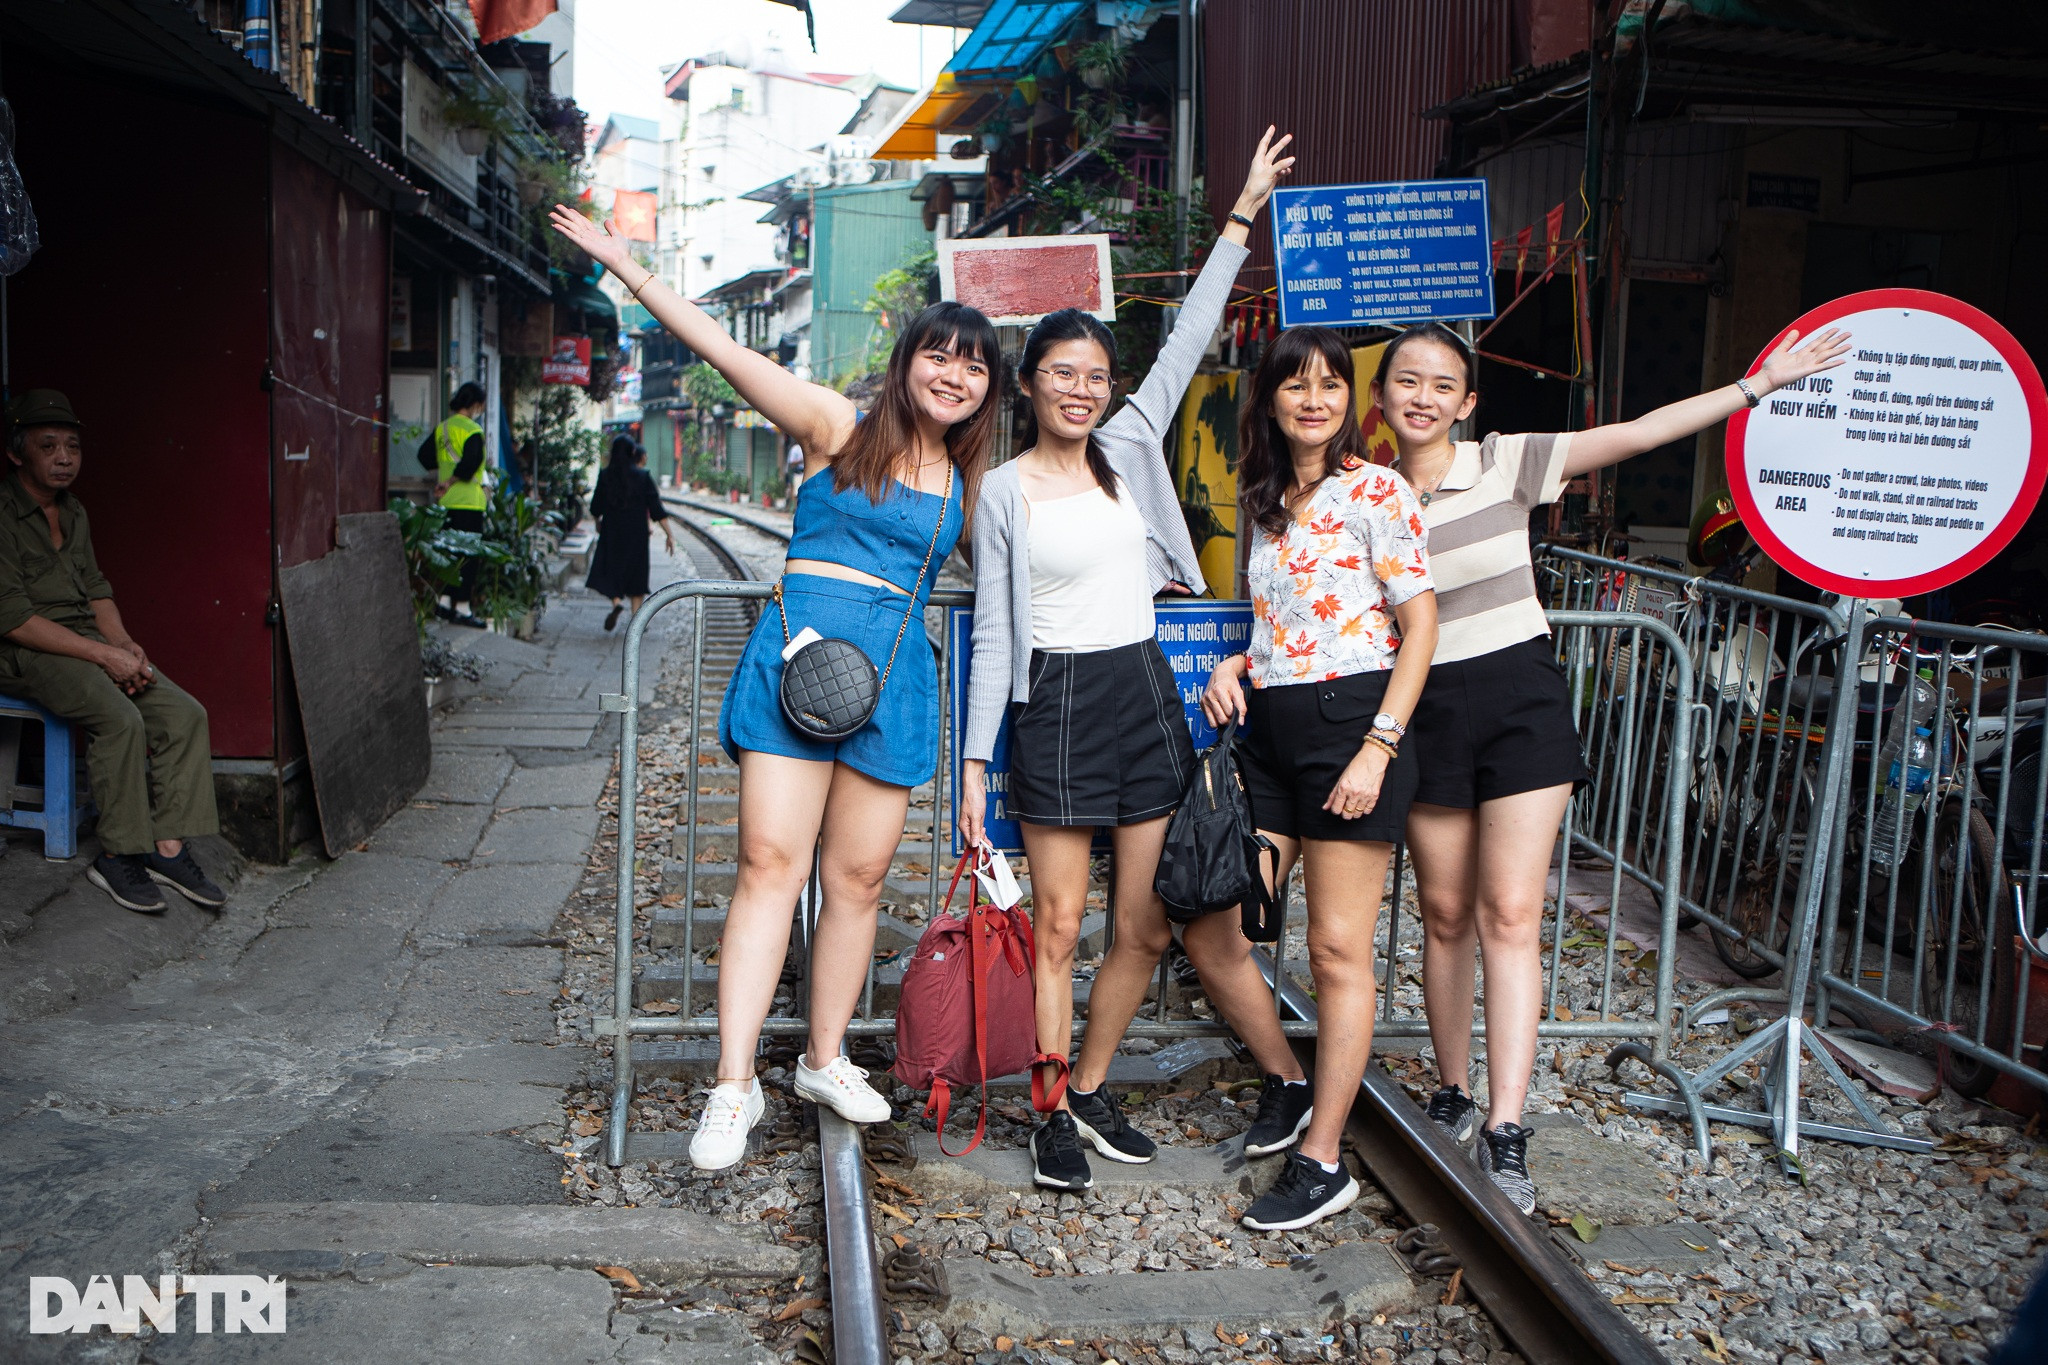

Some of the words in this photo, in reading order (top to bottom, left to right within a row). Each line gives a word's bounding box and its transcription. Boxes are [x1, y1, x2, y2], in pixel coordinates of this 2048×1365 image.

[1422, 191, 1436, 204] QUAY
[1286, 206, 1308, 222] KHU
[1311, 204, 1333, 225] VỰC
[1283, 233, 1312, 249] NGUY
[1315, 225, 1343, 247] HIỂM
[1444, 226, 1462, 237] TRONG
[1357, 251, 1368, 262] HAI
[1352, 268, 1360, 276] DO
[1361, 267, 1372, 276] NOT
[1373, 266, 1394, 275] GATHER
[1395, 265, 1399, 274] A
[1460, 262, 1479, 271] VIDEOS
[1287, 278, 1342, 292] DANGEROUS
[1353, 282, 1362, 290] DO
[1363, 281, 1374, 290] NOT
[1413, 278, 1421, 286] SIT
[1423, 277, 1431, 286] ON
[1432, 276, 1457, 285] RAILROAD
[1458, 275, 1479, 284] TRACKS
[1303, 297, 1327, 311] AREA
[1363, 294, 1375, 303] NOT
[1375, 293, 1398, 302] DISPLAY
[1421, 291, 1441, 300] TABLES
[1442, 290, 1453, 299] AND
[1475, 289, 1483, 297] ON
[1352, 309, 1364, 318] AND
[1365, 308, 1382, 317] ALONG
[1384, 306, 1410, 316] RAILROAD
[1411, 305, 1431, 314] TRACKS
[1858, 350, 1883, 364] Không
[1885, 352, 1893, 366] tụ
[1895, 353, 1908, 367] tập
[1910, 354, 1930, 368] đông
[1932, 356, 1957, 370] người,
[1959, 359, 1979, 372] quay
[1981, 361, 2004, 374] phim,
[1810, 377, 1833, 396] VỰC
[1854, 371, 1874, 384] chụp
[1876, 370, 1891, 383] ảnh
[1770, 400, 1803, 417] NGUY
[1806, 398, 1837, 420] HIỂM
[1852, 389, 1877, 403] Không
[1880, 391, 1889, 404] đi,
[1935, 395, 1951, 407] trên
[1954, 397, 1979, 411] đường
[1981, 397, 1994, 411] sắt
[1849, 408, 1875, 422] Không
[1876, 411, 1886, 422] kê
[1888, 411, 1904, 424] bàn
[1905, 412, 1922, 426] ghế,
[1958, 417, 1979, 431] hàng
[1846, 427, 1867, 441] trong
[1868, 429, 1886, 443] lòng
[1888, 431, 1898, 443] và
[1899, 432, 1912, 444] hai
[1914, 433, 1929, 446] bên
[1931, 435, 1957, 449] đường
[1958, 435, 1971, 449] sắt
[1759, 469, 1831, 489] DANGEROUS
[1842, 468, 1851, 480] Do
[1852, 470, 1864, 481] not
[1865, 472, 1888, 483] gather
[1889, 474, 1894, 483] a
[1895, 474, 1919, 487] crowd,
[1921, 476, 1936, 487] take
[1937, 477, 1962, 491] photos,
[1965, 480, 1988, 492] videos
[1775, 496, 1807, 512] AREA
[1839, 488, 1848, 499] Do
[1850, 490, 1861, 501] not
[1862, 491, 1881, 503] walk,
[1883, 492, 1904, 505] stand,
[1905, 494, 1914, 505] sit
[1916, 496, 1925, 506] on
[1926, 497, 1954, 509] railroad
[1956, 499, 1978, 511] tracks
[1836, 507, 1845, 518] Do
[1847, 509, 1858, 520] not
[1860, 508, 1884, 523] display
[1886, 511, 1909, 525] chairs,
[1911, 513, 1933, 526] Tables
[1935, 516, 1947, 528] and
[1949, 517, 1974, 531] peddle
[1975, 521, 1984, 531] on
[1833, 526, 1845, 537] and
[1847, 527, 1866, 541] along
[1868, 529, 1895, 542] railroad
[1896, 532, 1918, 545] tracks
[1646, 593, 1664, 605] POLICE
[1158, 620, 1185, 642] ĐÔNG
[1187, 619, 1220, 643] NGƯỜI,
[1223, 623, 1248, 643] QUAY
[1170, 650, 1194, 673] NGỒI
[1196, 651, 1220, 673] TRÊN
